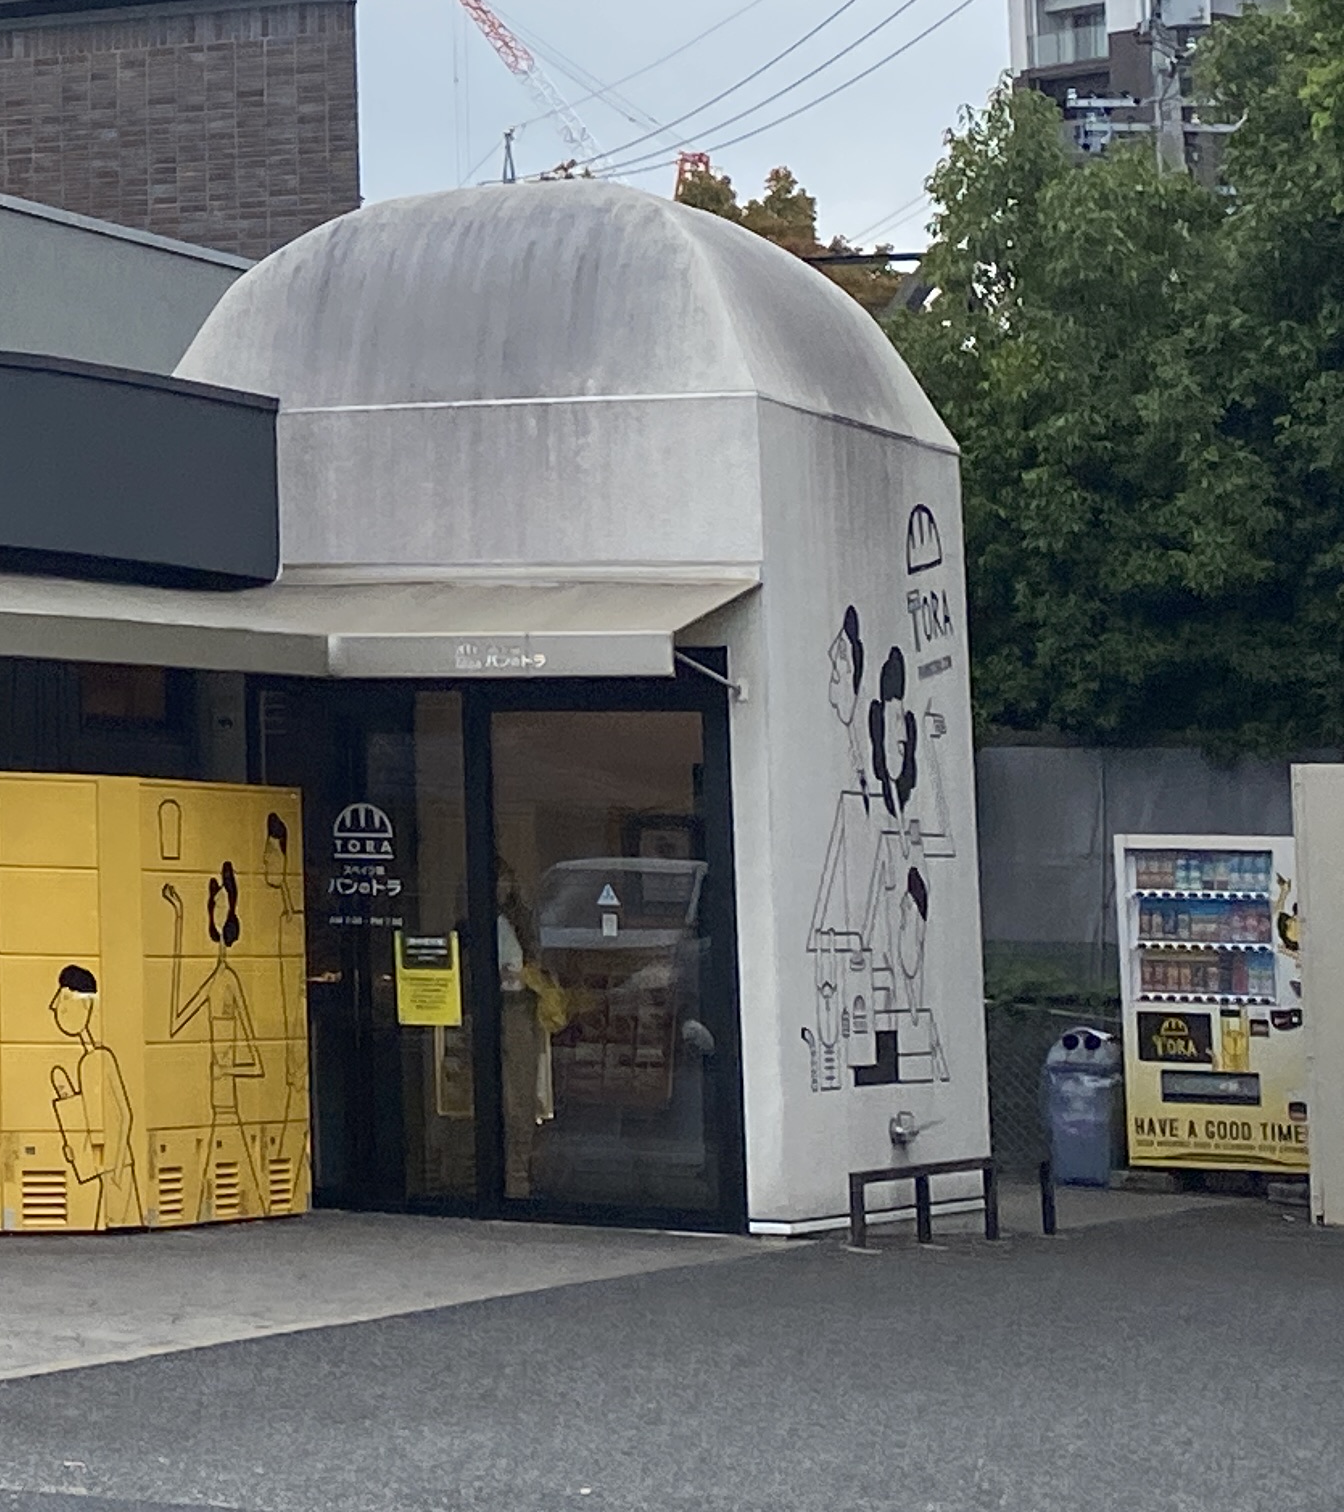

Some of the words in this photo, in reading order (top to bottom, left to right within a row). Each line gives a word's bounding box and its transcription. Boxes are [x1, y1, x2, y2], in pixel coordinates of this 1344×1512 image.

[906, 589, 954, 652] TORA
[335, 839, 392, 853] TORA
[327, 878, 401, 896] パンのトラ
[1152, 1034, 1198, 1057] TORA
[1134, 1117, 1179, 1138] HAVE
[1187, 1120, 1198, 1140] A
[1204, 1120, 1252, 1141] GOOD
[1260, 1122, 1305, 1144] TIME
